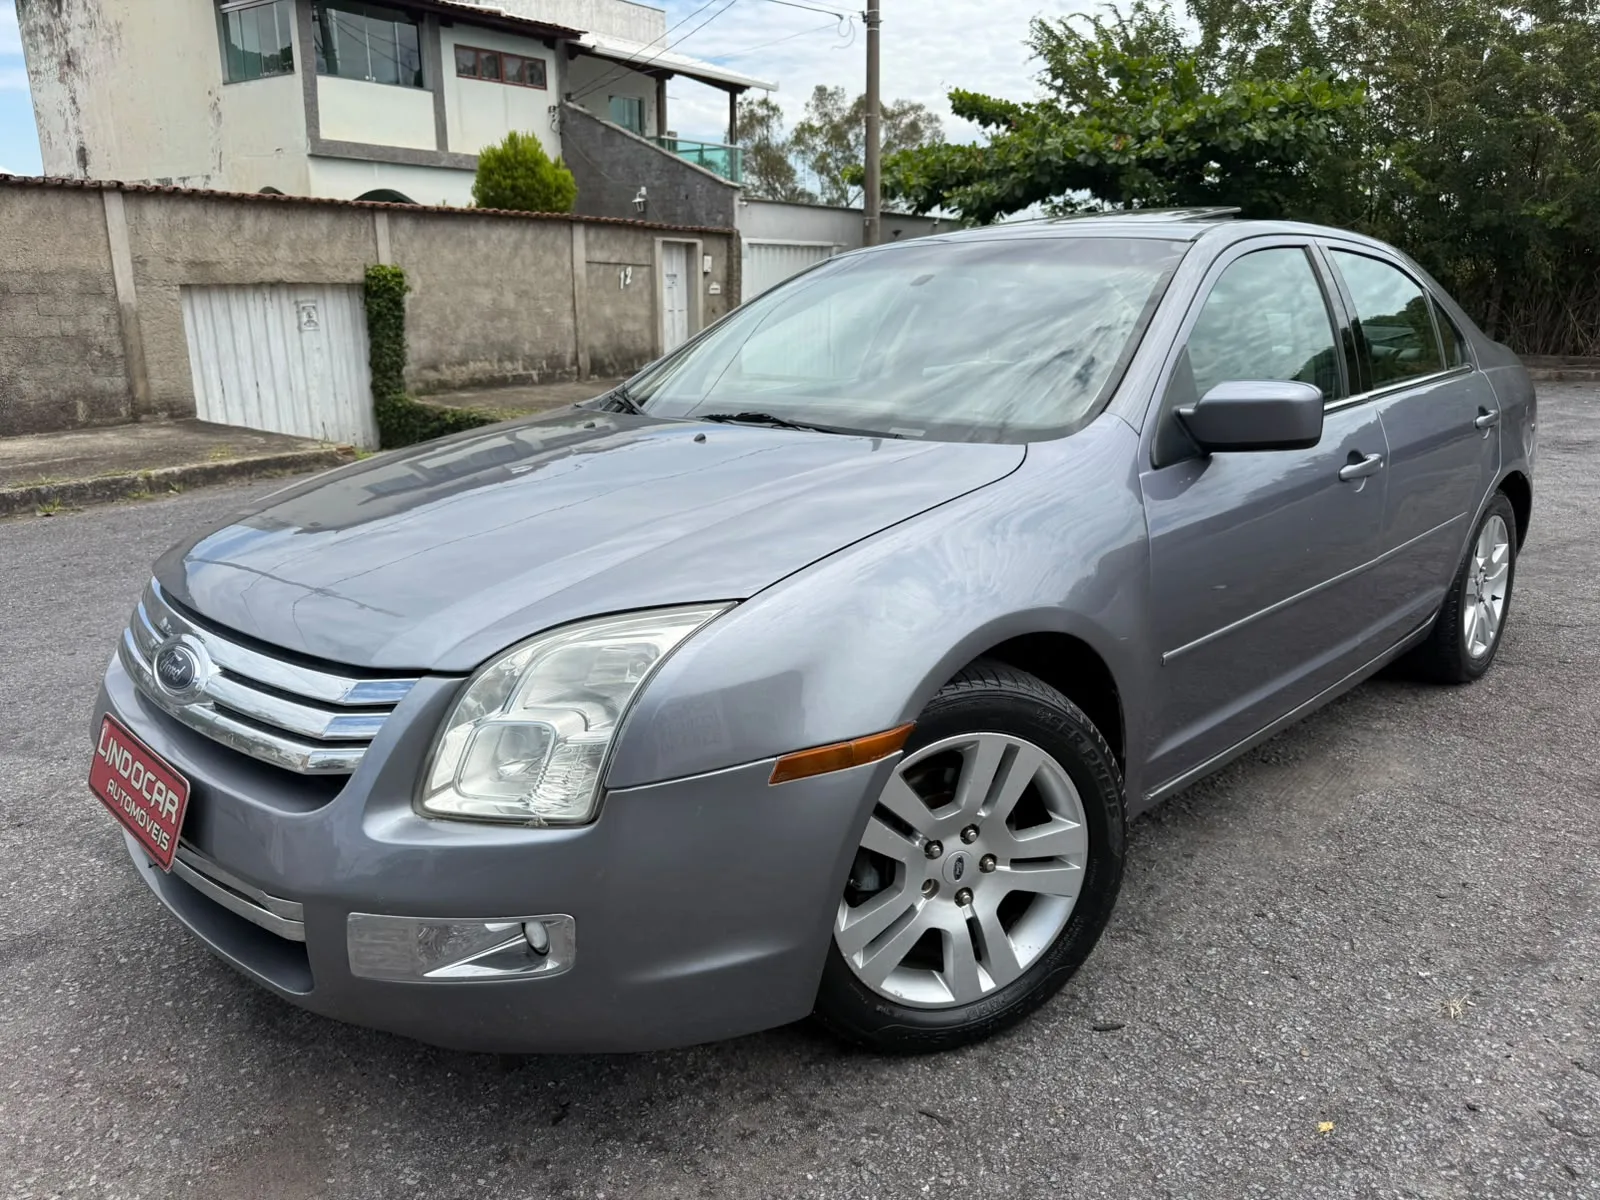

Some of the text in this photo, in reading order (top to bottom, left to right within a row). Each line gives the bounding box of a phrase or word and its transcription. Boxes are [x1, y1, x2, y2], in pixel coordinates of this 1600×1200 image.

[620, 266, 632, 290] 12
[97, 724, 179, 824] LINDOCAR
[106, 778, 170, 851] AUTOMÓVEIS
